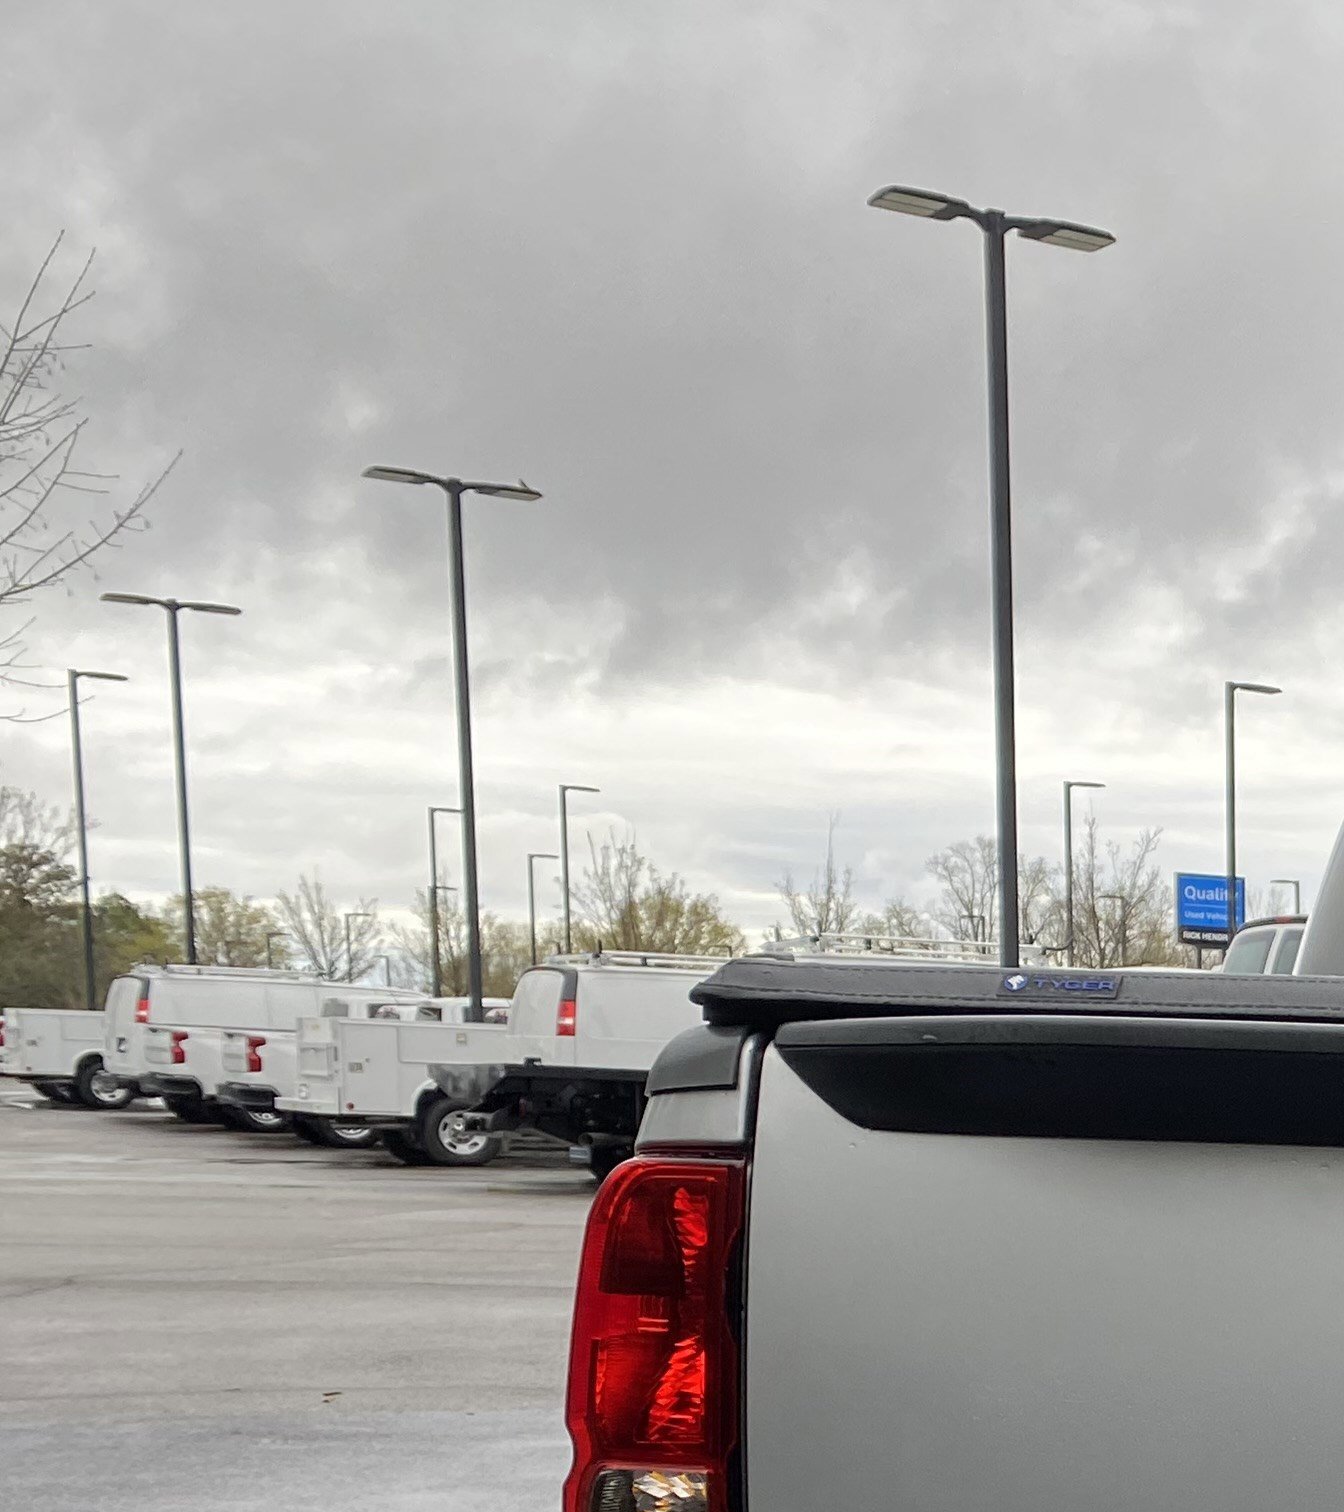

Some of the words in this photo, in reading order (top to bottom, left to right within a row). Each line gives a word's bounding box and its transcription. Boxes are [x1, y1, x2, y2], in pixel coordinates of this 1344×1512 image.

[1184, 885, 1239, 903] Qualit
[1184, 910, 1205, 919] Used
[1182, 930, 1201, 940] RICK
[1202, 932, 1229, 942] HENDR
[1033, 978, 1116, 991] TYGER
